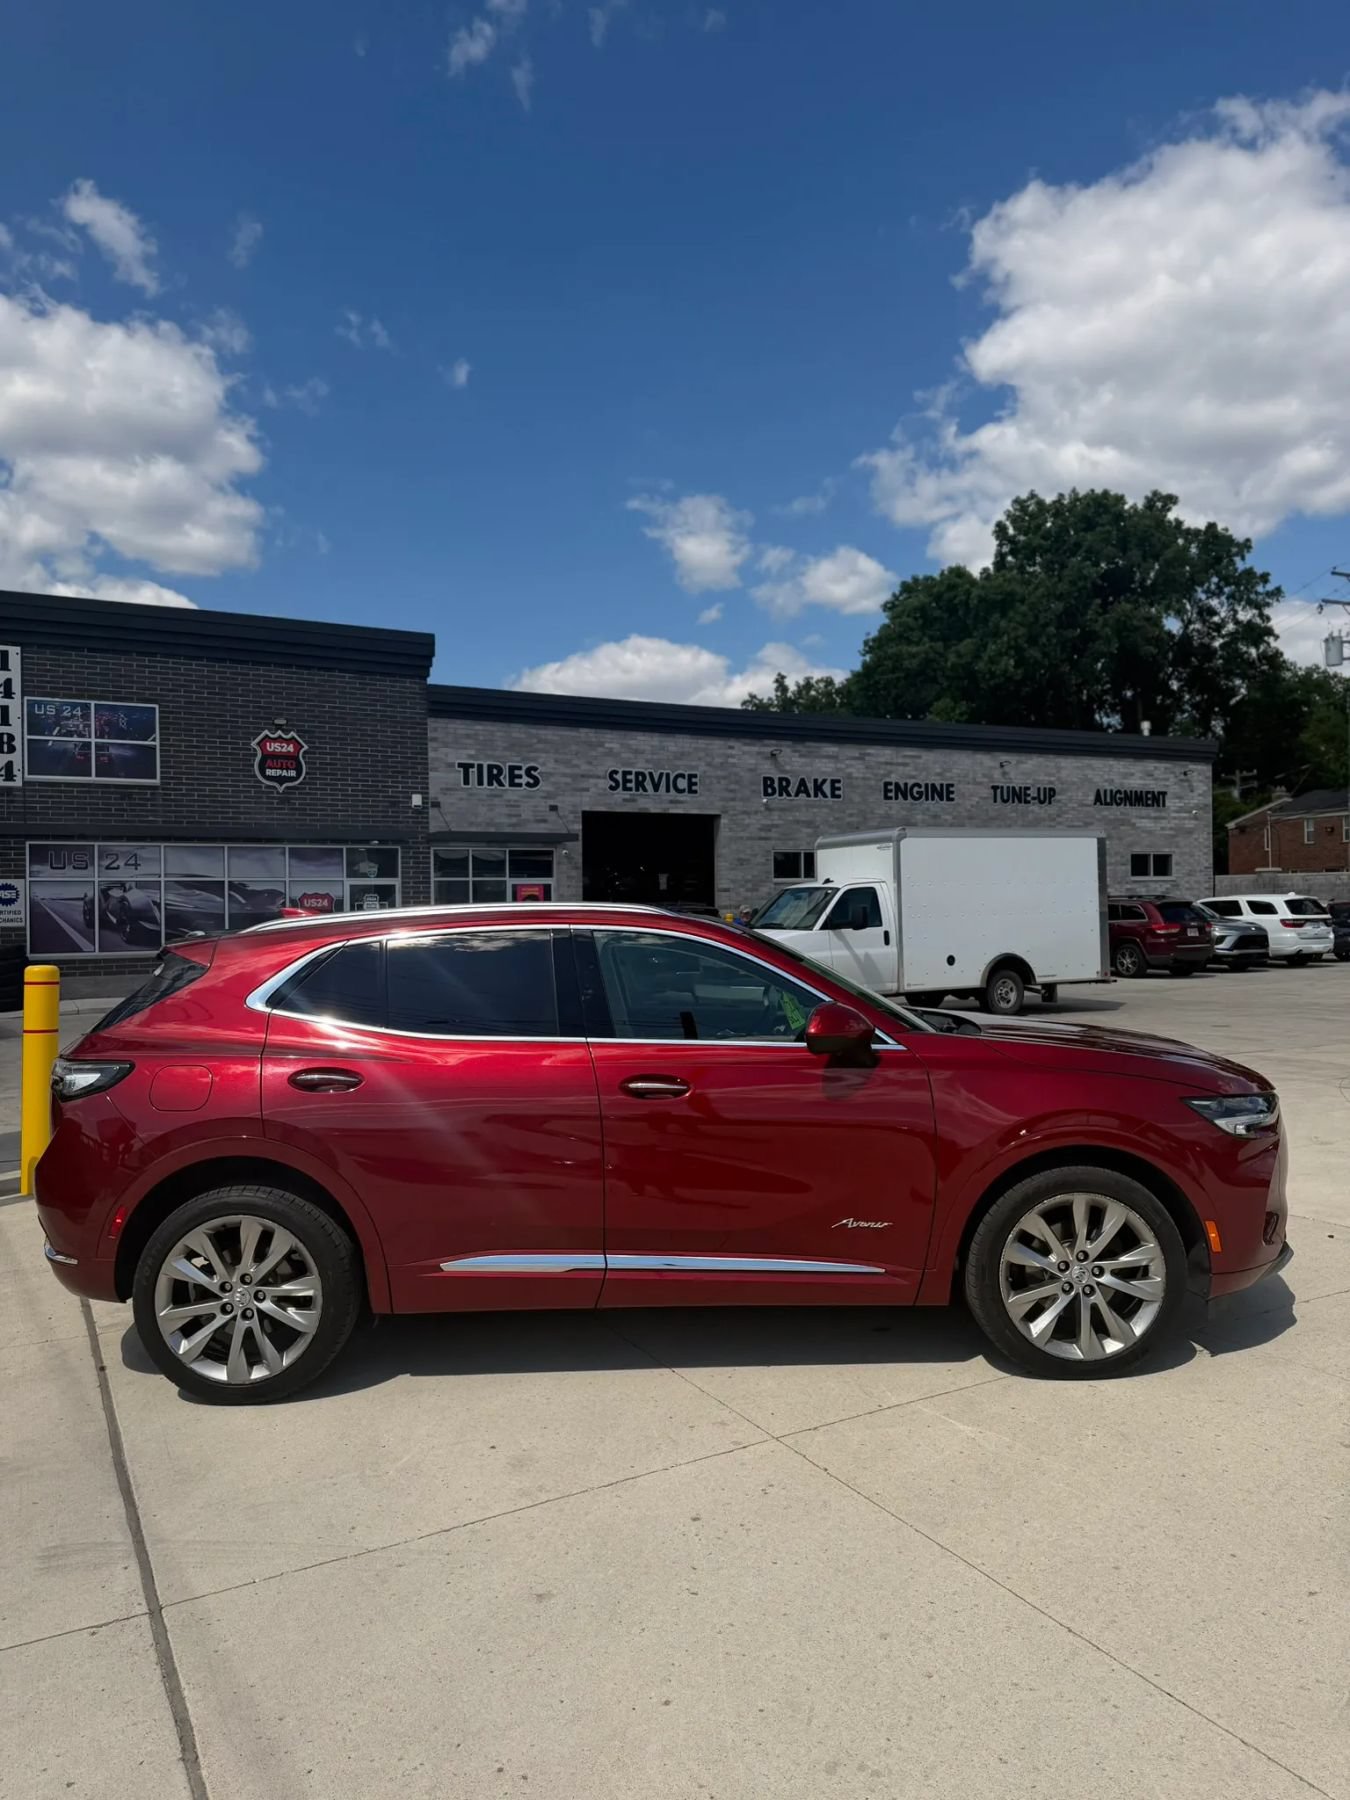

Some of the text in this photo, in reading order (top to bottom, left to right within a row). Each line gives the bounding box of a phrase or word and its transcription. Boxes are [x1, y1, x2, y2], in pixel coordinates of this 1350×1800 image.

[34, 703, 83, 718] US 24
[265, 742, 295, 753] US24
[265, 759, 297, 769] AUTO
[265, 768, 297, 777] REPAIR
[456, 761, 542, 790] TIRES
[607, 768, 699, 795] SERVICE
[762, 775, 842, 799] BRAKE
[882, 781, 956, 802] ENGINE
[990, 785, 1057, 805] TUNE-UP
[1093, 788, 1168, 808] ALIGNMENT
[48, 850, 142, 871] US 24
[303, 898, 330, 908] US24
